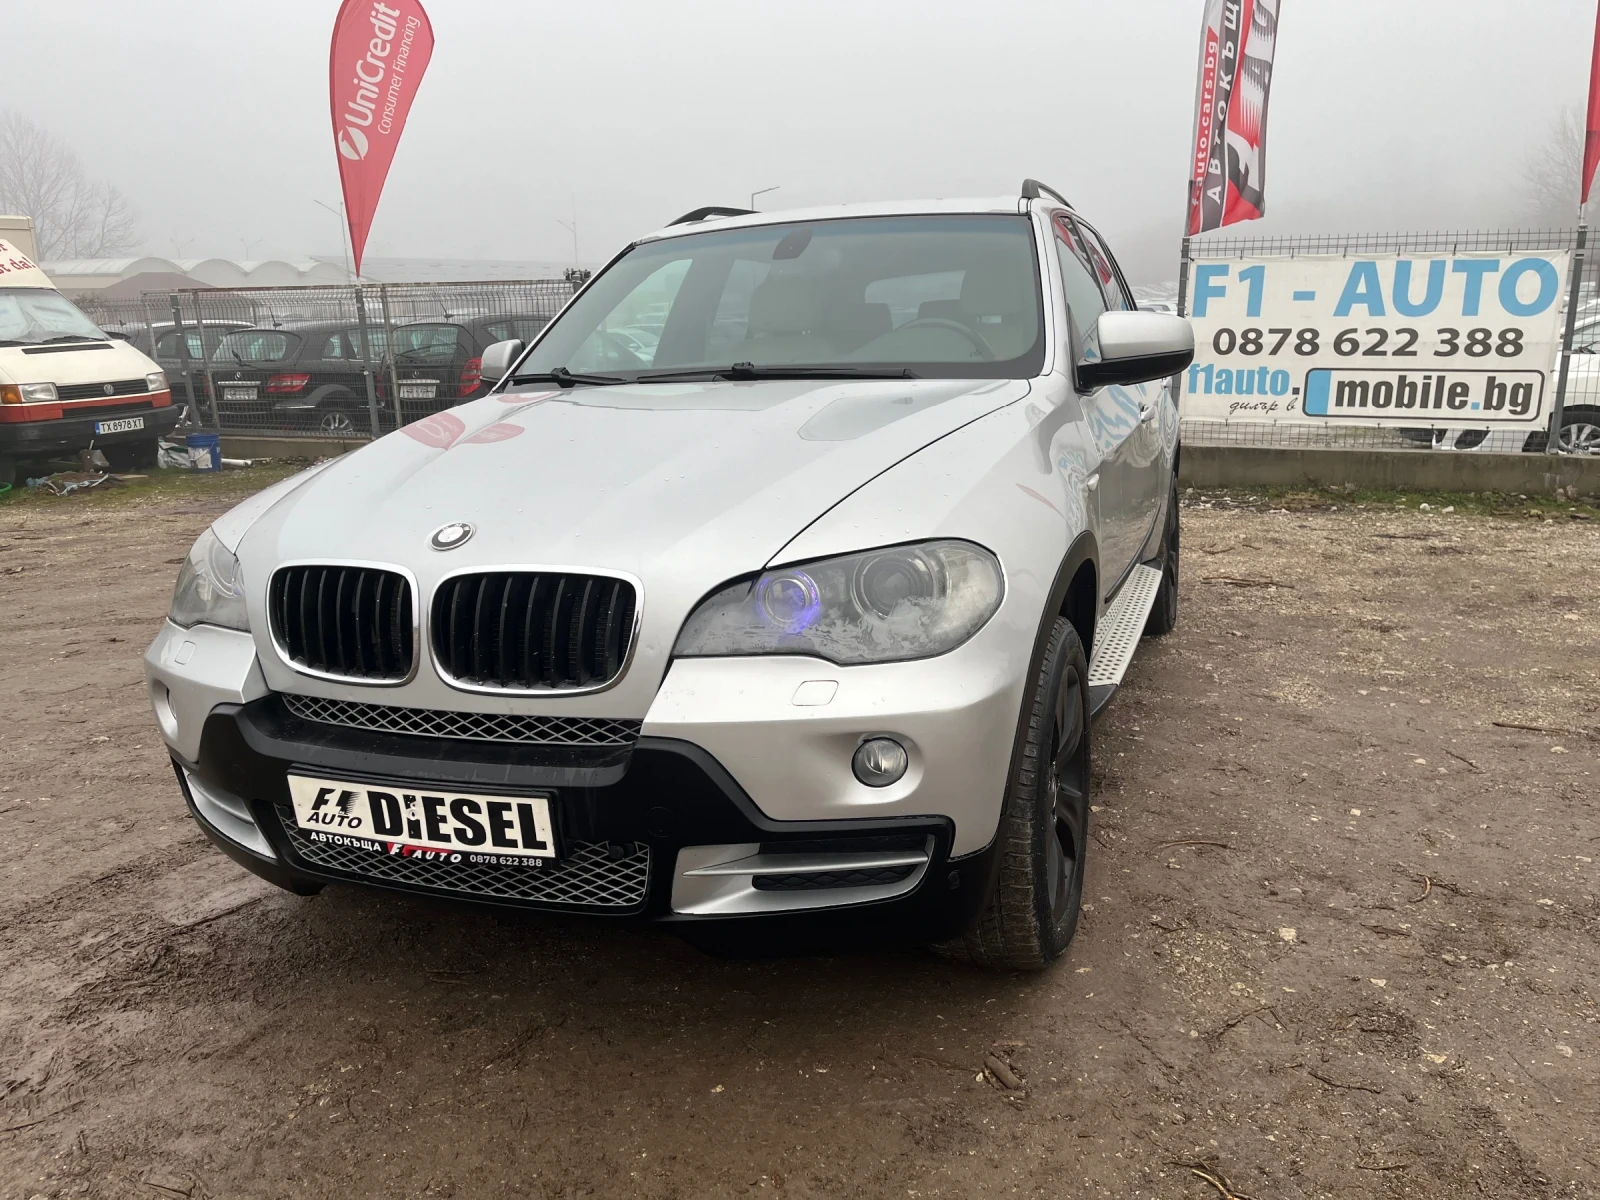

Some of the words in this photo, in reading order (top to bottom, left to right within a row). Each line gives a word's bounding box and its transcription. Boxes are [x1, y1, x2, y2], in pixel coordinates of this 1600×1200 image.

[344, 2, 400, 127] UniCredit
[378, 73, 403, 135] Consumer
[392, 15, 421, 73] Financing
[1191, 264, 1266, 318] F1
[1332, 257, 1559, 318] AUTO
[1212, 327, 1320, 357] 0878
[1333, 327, 1419, 357] 622
[1433, 327, 1524, 358] 388
[1334, 374, 1534, 416] mobile.bg
[100, 422, 112, 432] TX
[112, 420, 132, 431] 8978
[306, 811, 362, 829] AUTO
[366, 790, 548, 850] DIESEL
[310, 831, 382, 851] АВТОКЪЩА
[411, 849, 462, 863] AUTO
[469, 854, 497, 864] 0878
[499, 856, 519, 866] 622
[521, 857, 543, 867] 388
